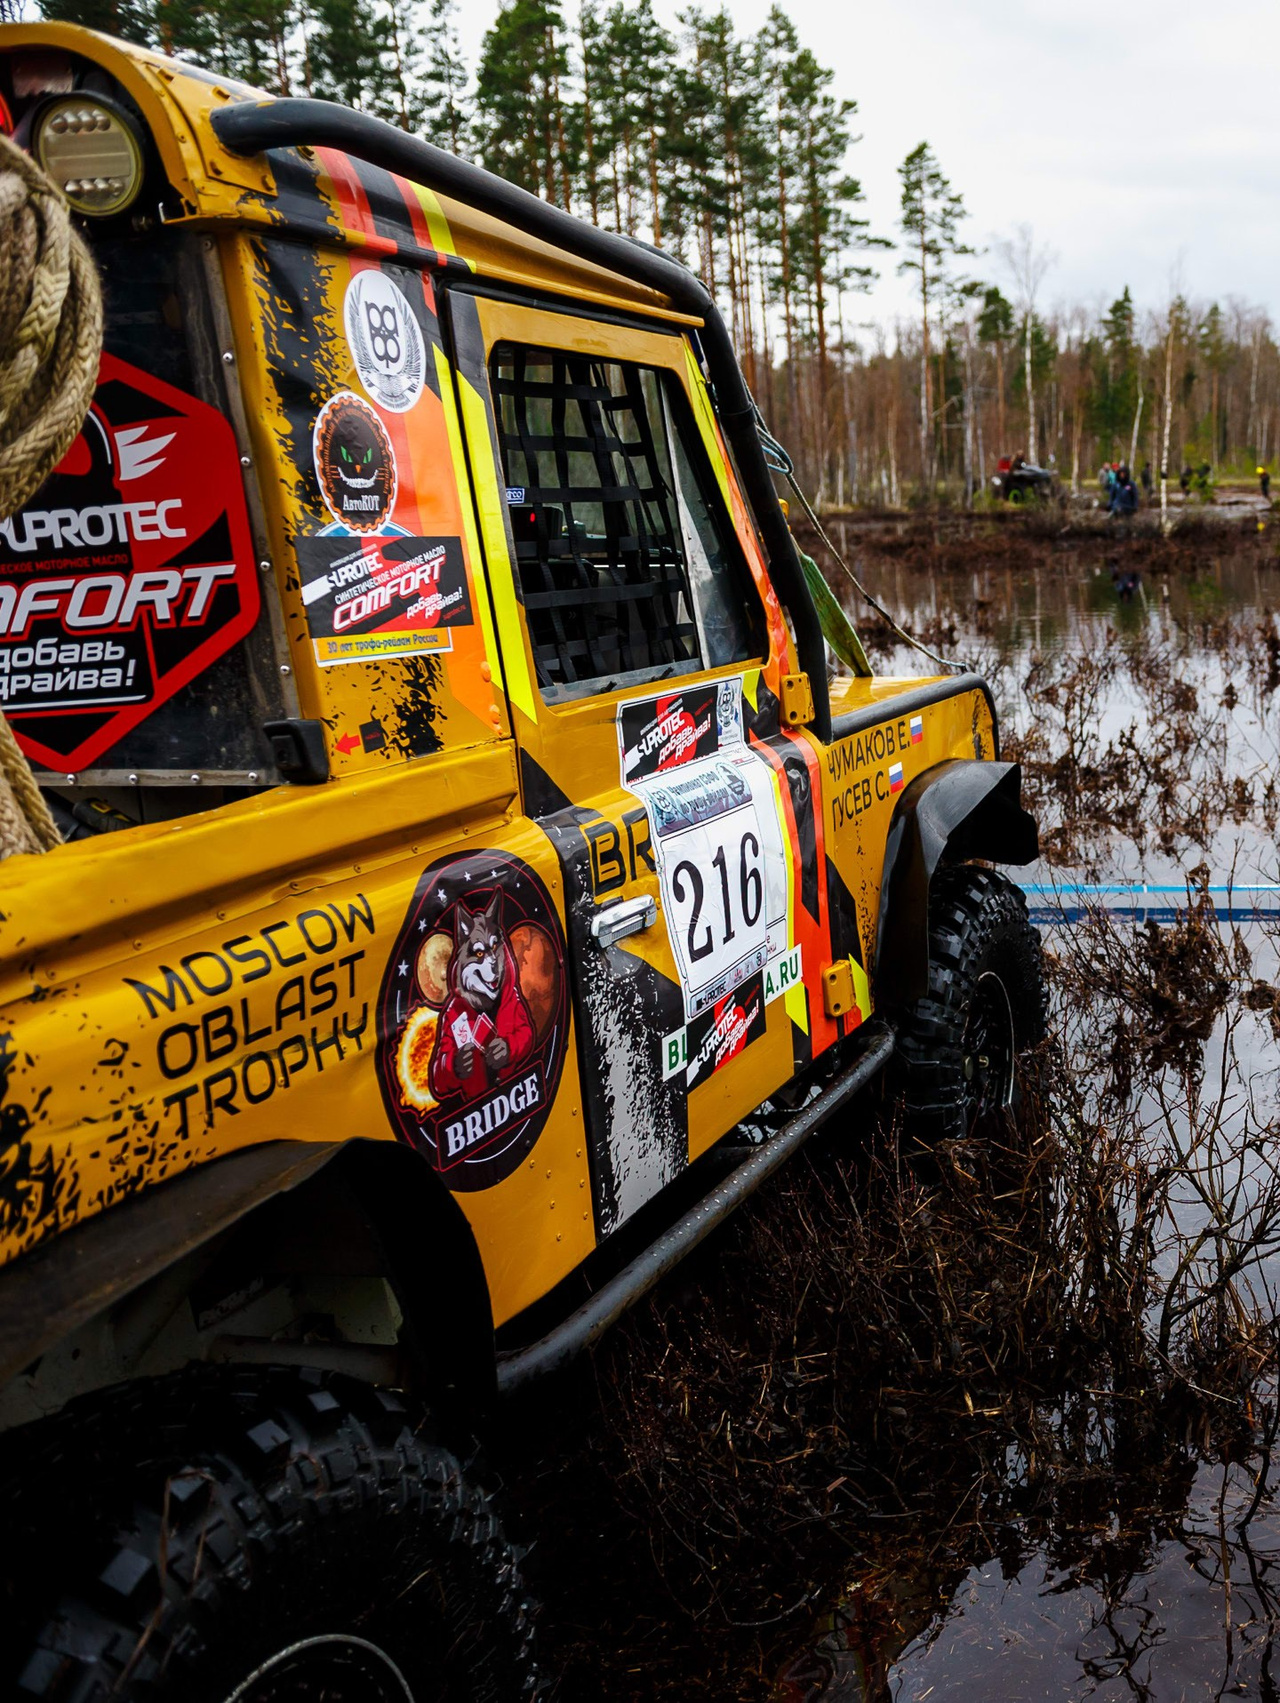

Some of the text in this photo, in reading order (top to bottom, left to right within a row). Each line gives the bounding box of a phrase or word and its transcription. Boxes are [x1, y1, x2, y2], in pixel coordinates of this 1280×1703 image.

[35, 557, 91, 570] МОТОРНОЕ
[92, 554, 128, 566] МАСЛО
[334, 545, 446, 605] СИНТЕТИЧЕСКОЕ МОТОРНОЕ МАСЛО
[333, 557, 446, 630] COMFORT
[406, 593, 443, 620] добавь
[327, 634, 439, 654] 30 лет трофи-рейдам России
[658, 726, 693, 765] добавь
[826, 720, 911, 782] ЧУМАКОВ Е.
[832, 770, 890, 832] ГУСЕВ С.
[672, 832, 763, 963] 216
[122, 893, 375, 1019] MOSCOW
[765, 953, 798, 999] A.RU
[157, 950, 366, 1080] OBLAST
[163, 1002, 368, 1141] TROPHY
[445, 1073, 539, 1157] BRIDGE
